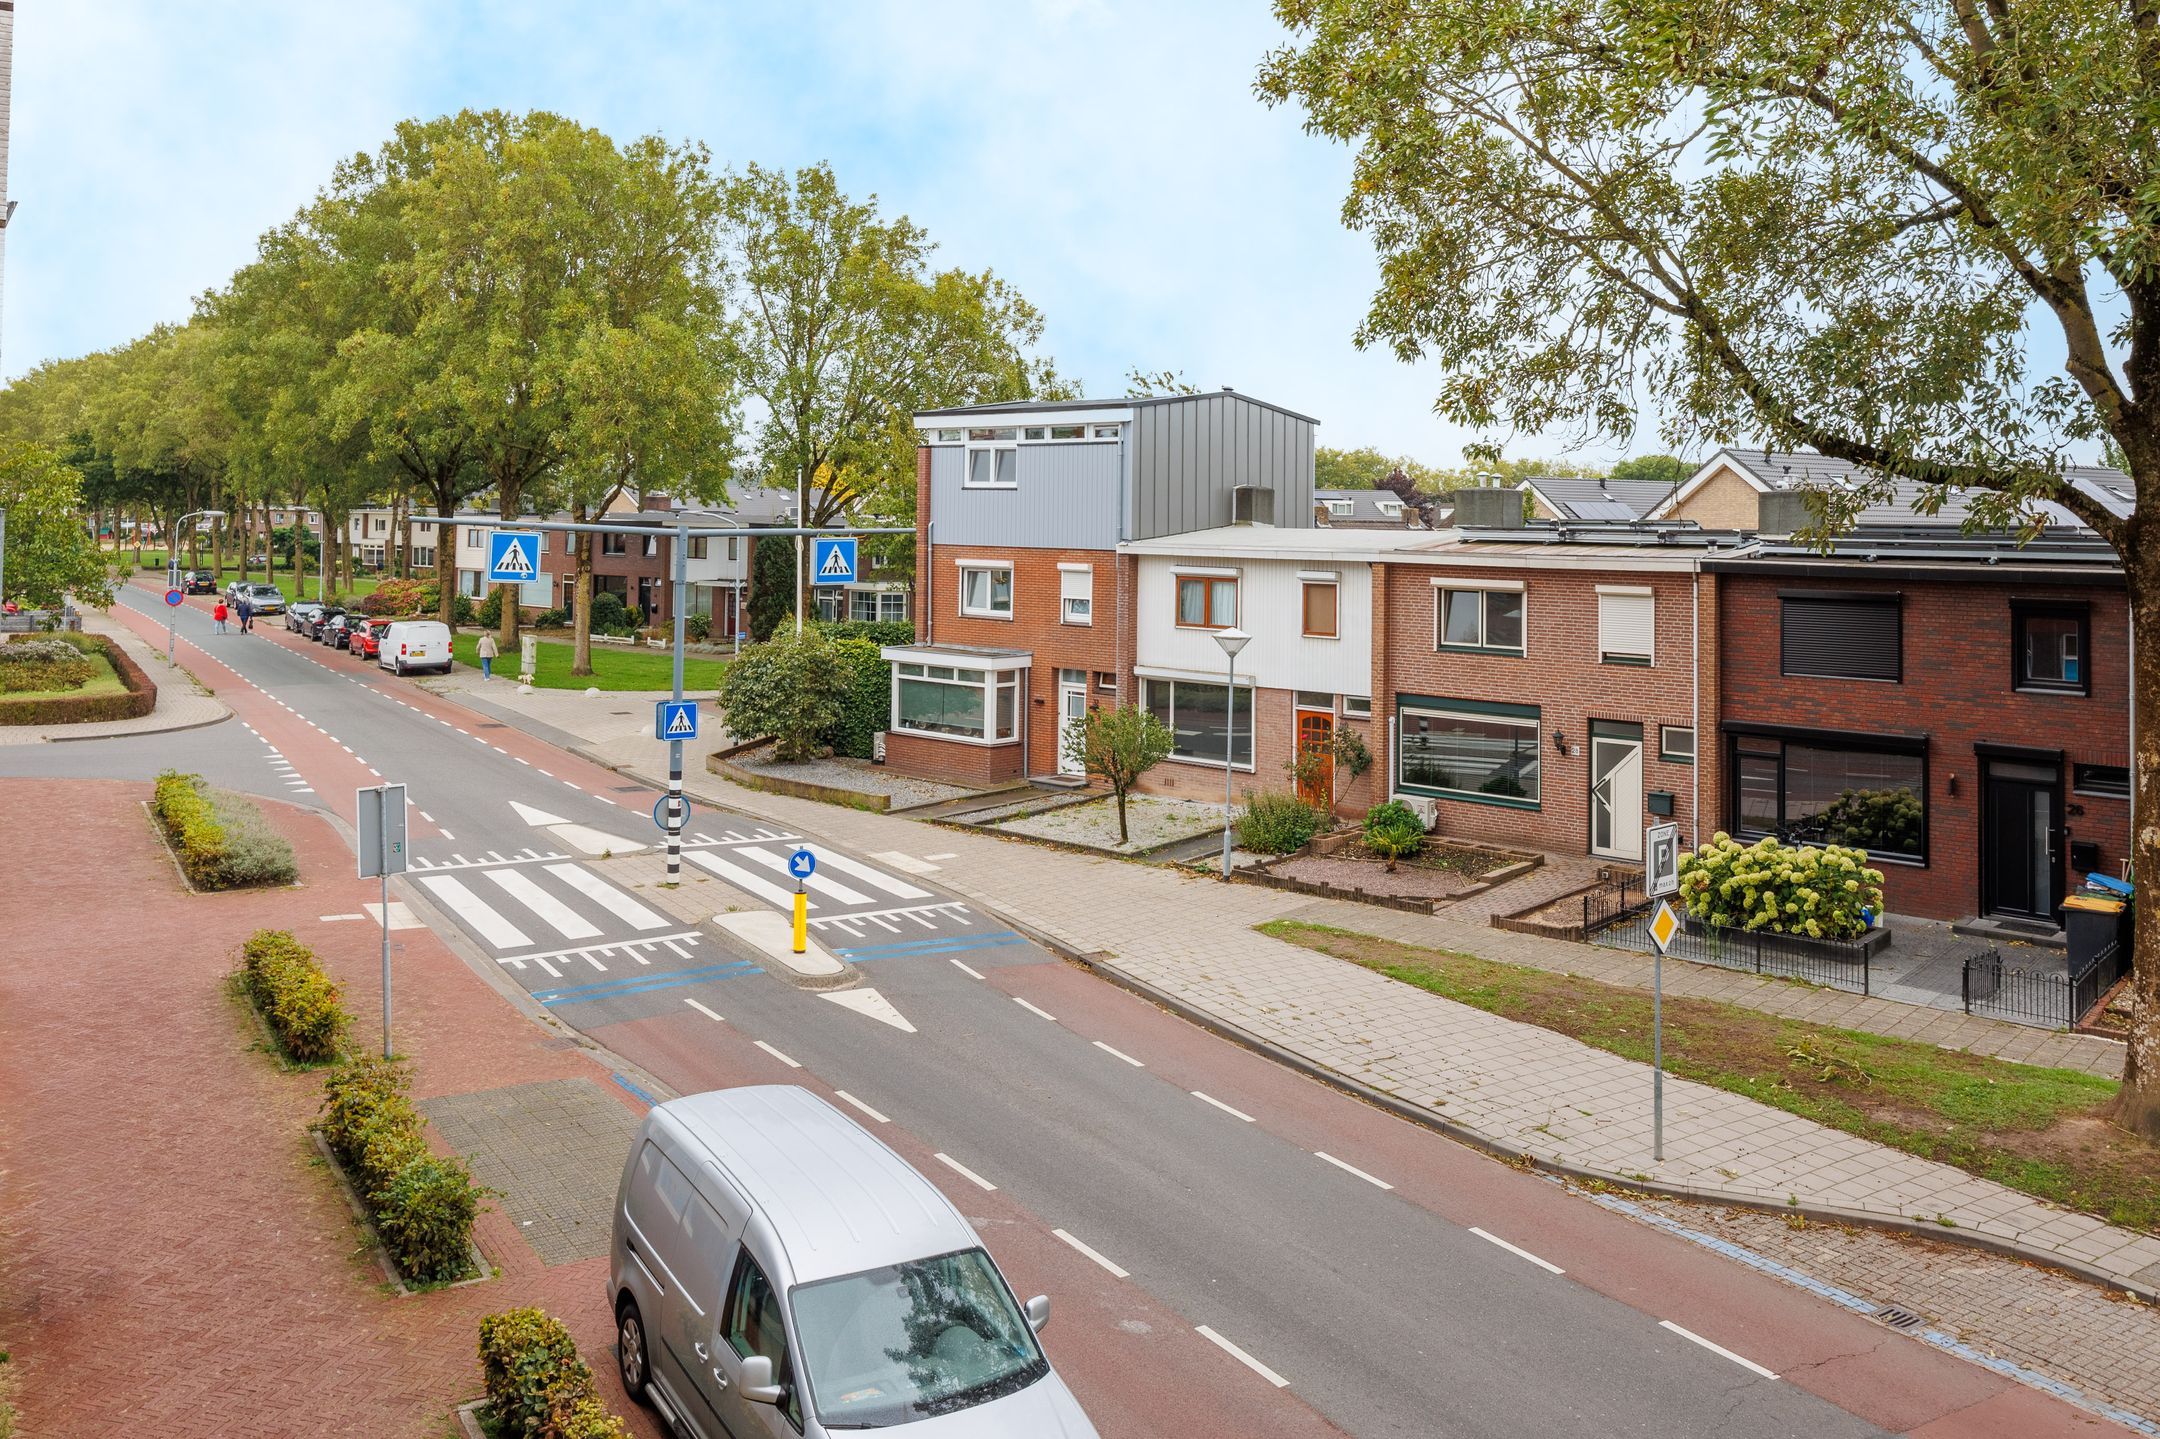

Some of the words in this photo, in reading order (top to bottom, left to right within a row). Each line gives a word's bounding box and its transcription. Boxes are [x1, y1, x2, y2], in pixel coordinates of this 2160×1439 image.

[2067, 804, 2084, 816] 26
[1657, 829, 1670, 839] ZONE
[1658, 844, 1670, 873] P
